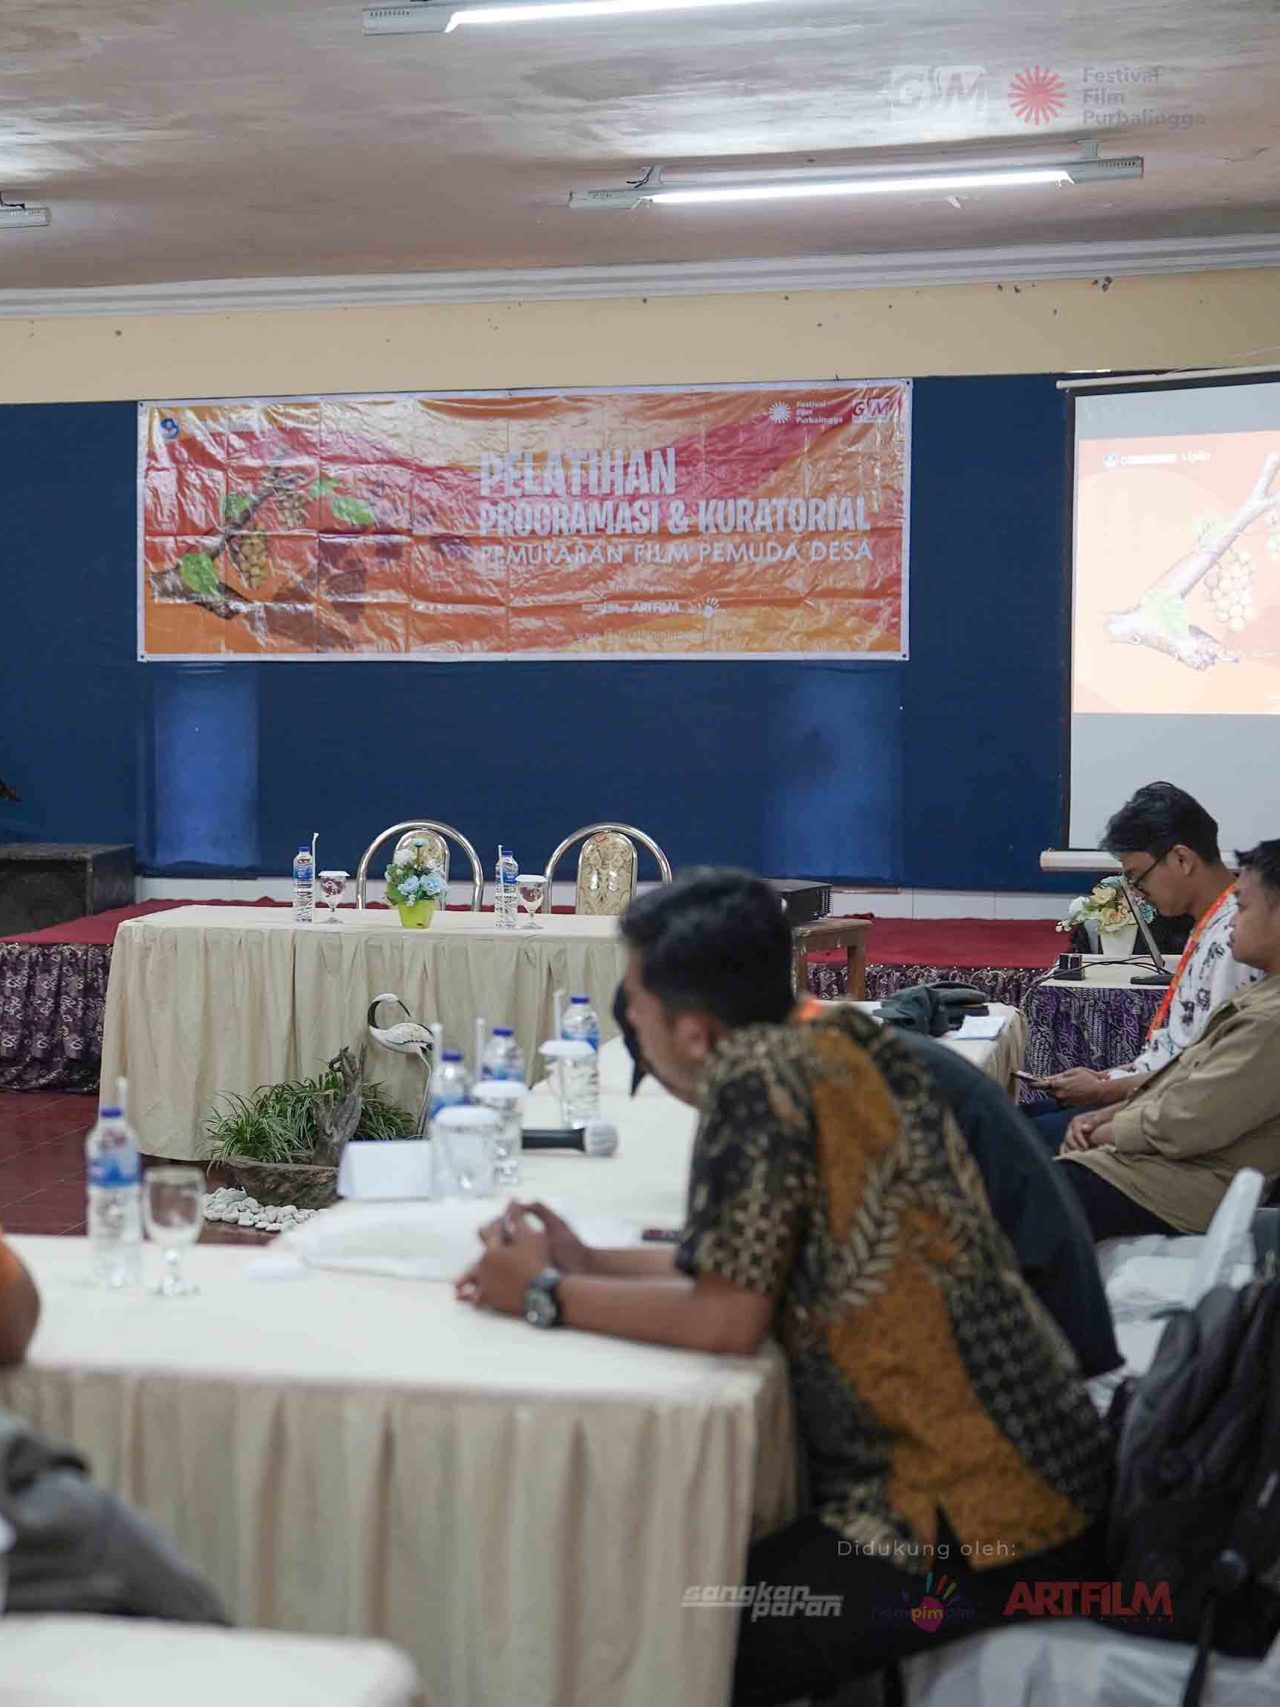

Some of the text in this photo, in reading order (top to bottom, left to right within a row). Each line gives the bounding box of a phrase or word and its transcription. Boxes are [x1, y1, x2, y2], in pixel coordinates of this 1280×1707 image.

[478, 448, 677, 499] PELATIHAN
[479, 491, 871, 536] PROGRAMASI & KURATORIAL
[480, 536, 874, 567] PEMUTARAN FILM PEMUDA DESA
